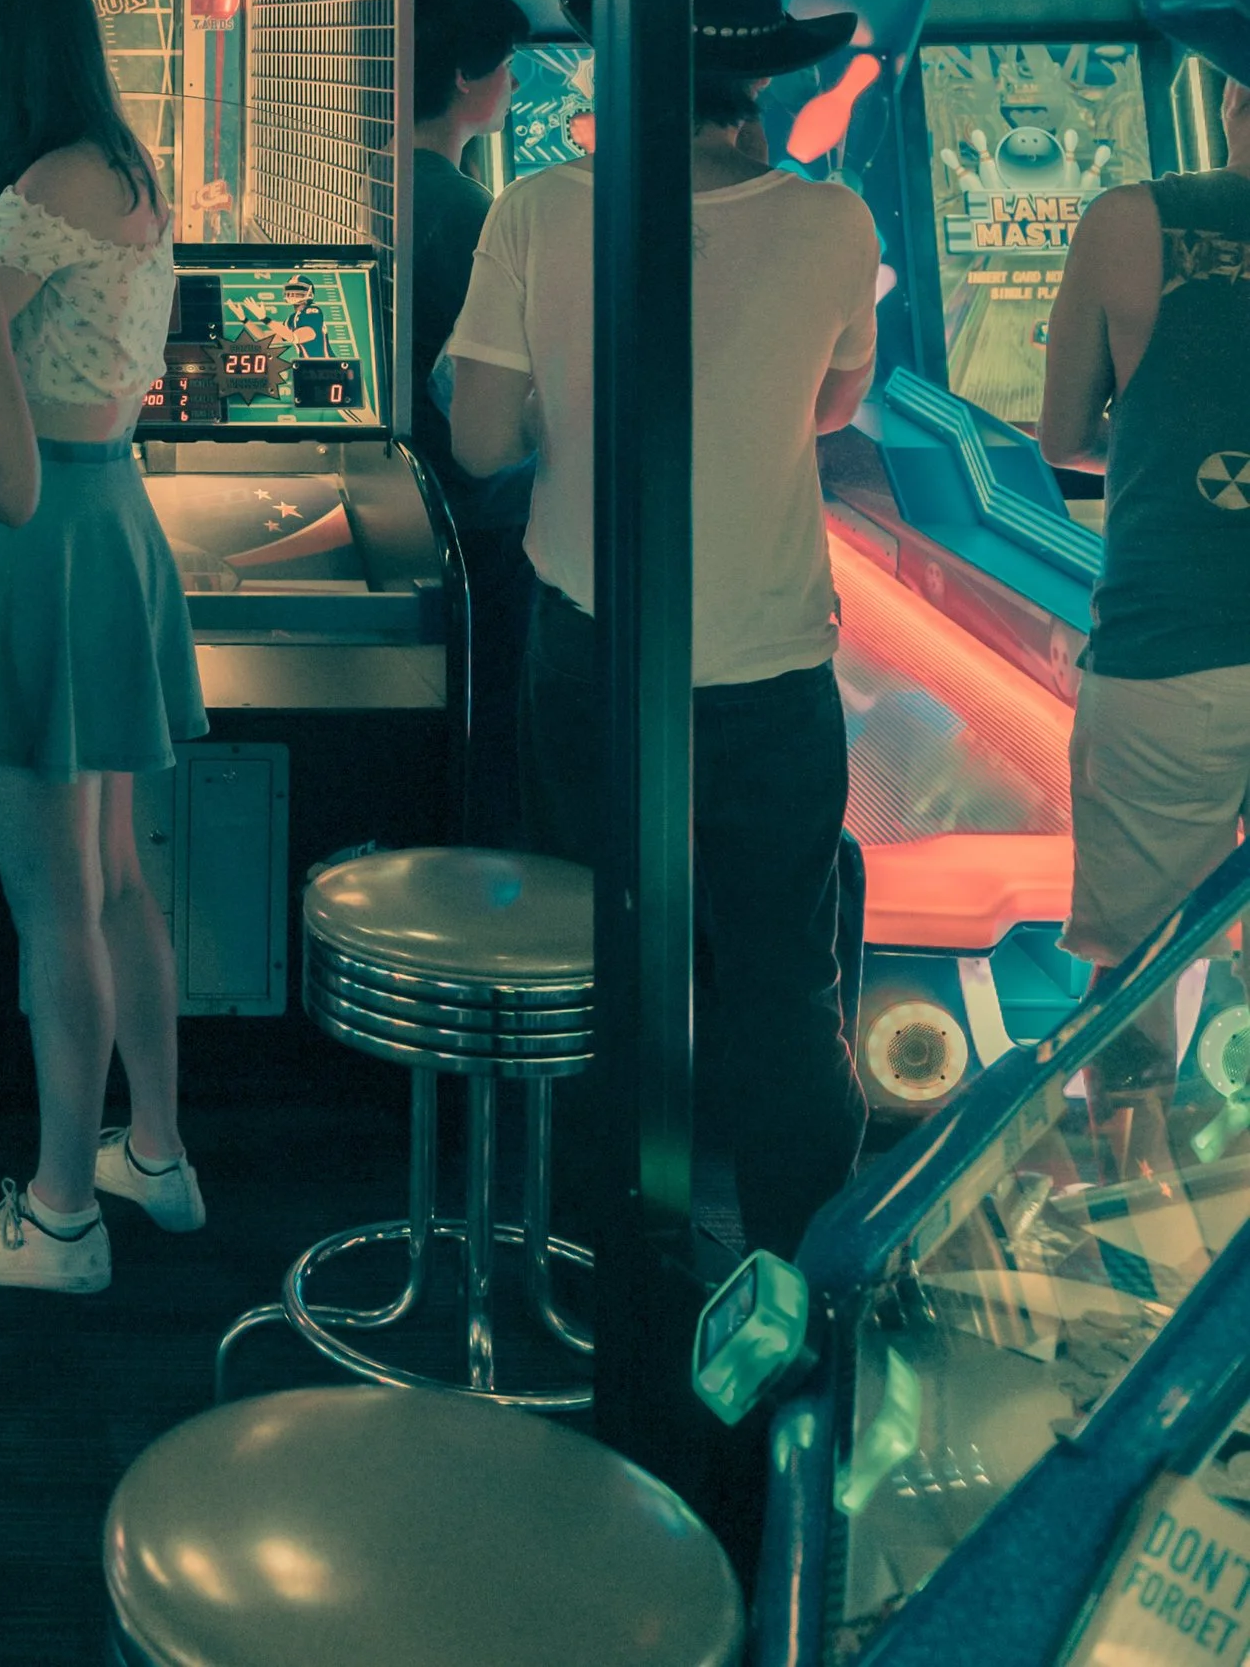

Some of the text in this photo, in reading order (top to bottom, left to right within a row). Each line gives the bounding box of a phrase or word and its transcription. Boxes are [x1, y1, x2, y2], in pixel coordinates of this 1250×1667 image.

[193, 19, 235, 31] YARDS
[191, 179, 232, 210] ICE
[991, 196, 1082, 222] LANE
[975, 222, 1075, 248] MAST
[225, 355, 267, 374] 250
[179, 379, 188, 391] 4
[329, 383, 343, 404] 0
[179, 395, 188, 406] 2
[1121, 1560, 1240, 1657] FORGET
